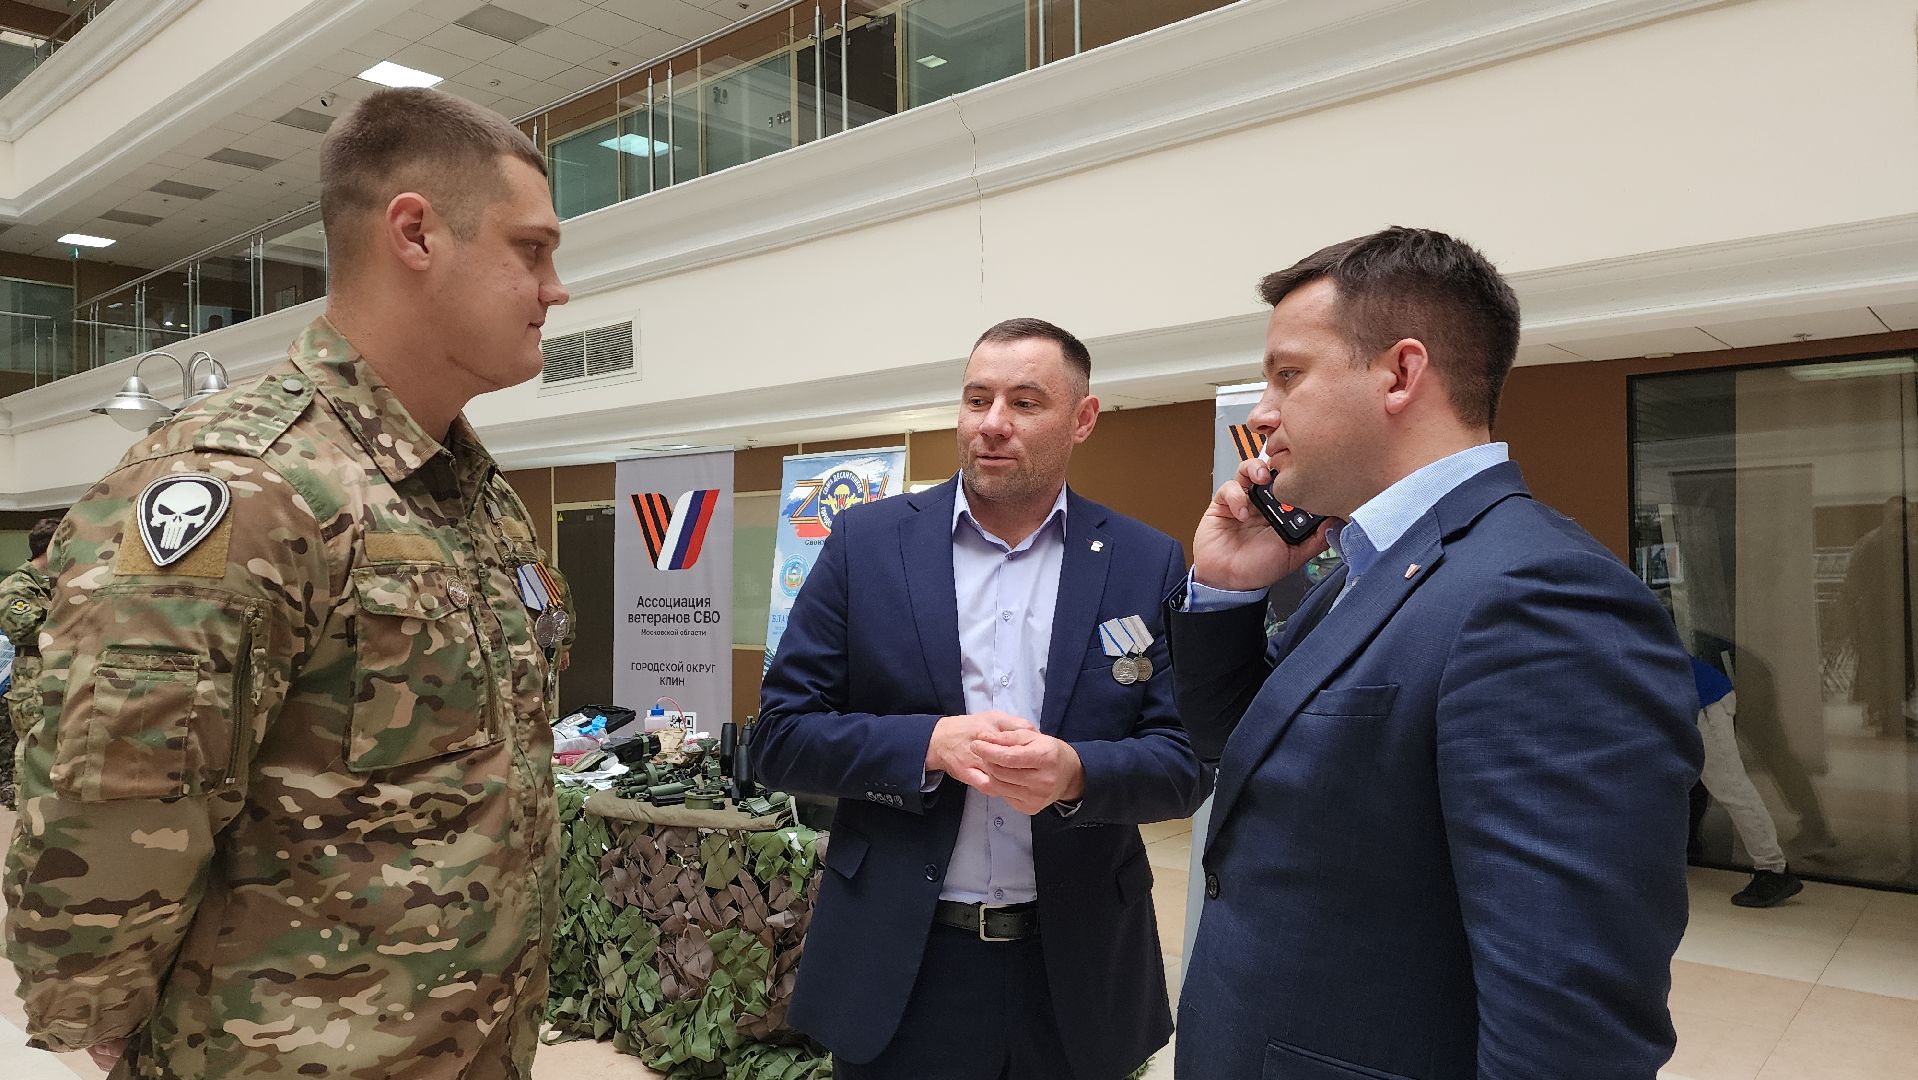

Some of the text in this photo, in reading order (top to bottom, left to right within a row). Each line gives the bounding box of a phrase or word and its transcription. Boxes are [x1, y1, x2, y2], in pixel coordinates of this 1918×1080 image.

[636, 595, 711, 610] Ассоциация
[627, 610, 721, 627] ветеранов СВО
[640, 628, 707, 637] Московской области
[631, 660, 716, 674] ГОРОДСКОЙ ОКРУГ
[659, 676, 685, 686] КЛИН
